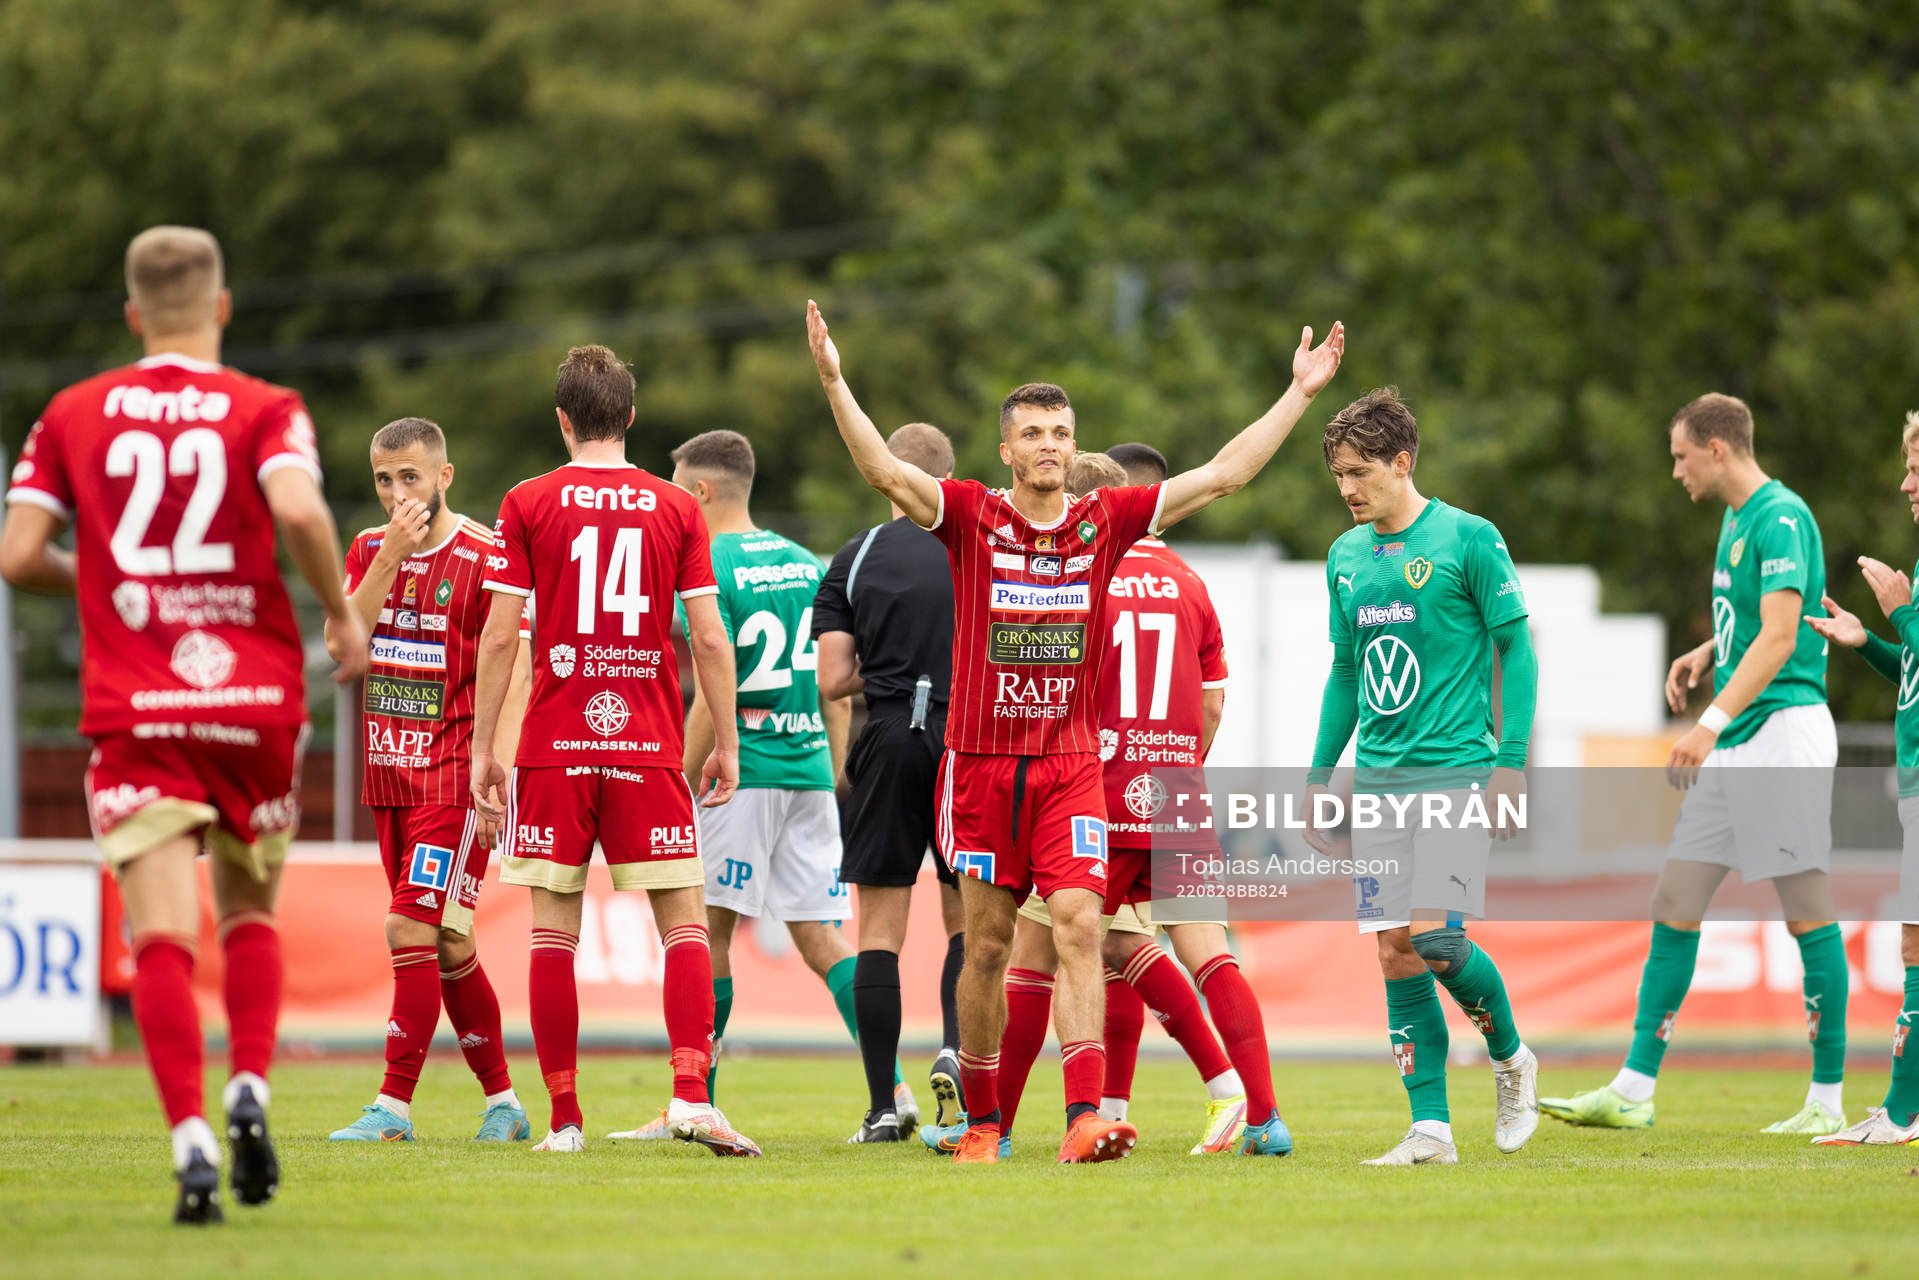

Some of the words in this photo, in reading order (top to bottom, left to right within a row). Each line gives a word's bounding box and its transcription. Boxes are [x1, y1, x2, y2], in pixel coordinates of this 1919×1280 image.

[103, 384, 231, 423] renta
[105, 428, 235, 576] 22
[561, 484, 656, 511] renta
[570, 526, 649, 636] 14
[1108, 572, 1179, 598] enta
[996, 589, 1084, 605] Perfectum
[1358, 602, 1415, 626] Atteviks
[997, 629, 1079, 645] GRÖNSAKS
[584, 644, 661, 664] Söderberg
[1019, 645, 1070, 659] HUSET
[1113, 611, 1176, 720] 17
[368, 681, 438, 701] GRÖNSAKS
[994, 672, 1075, 704] RAPP
[379, 696, 428, 714] HUSET
[368, 721, 433, 757] RAPP
[552, 739, 661, 752] COMPASSEN.NU
[1126, 729, 1197, 750] Söderberg
[517, 824, 554, 846] PULS
[649, 825, 694, 846] PULS
[717, 858, 753, 890] JP
